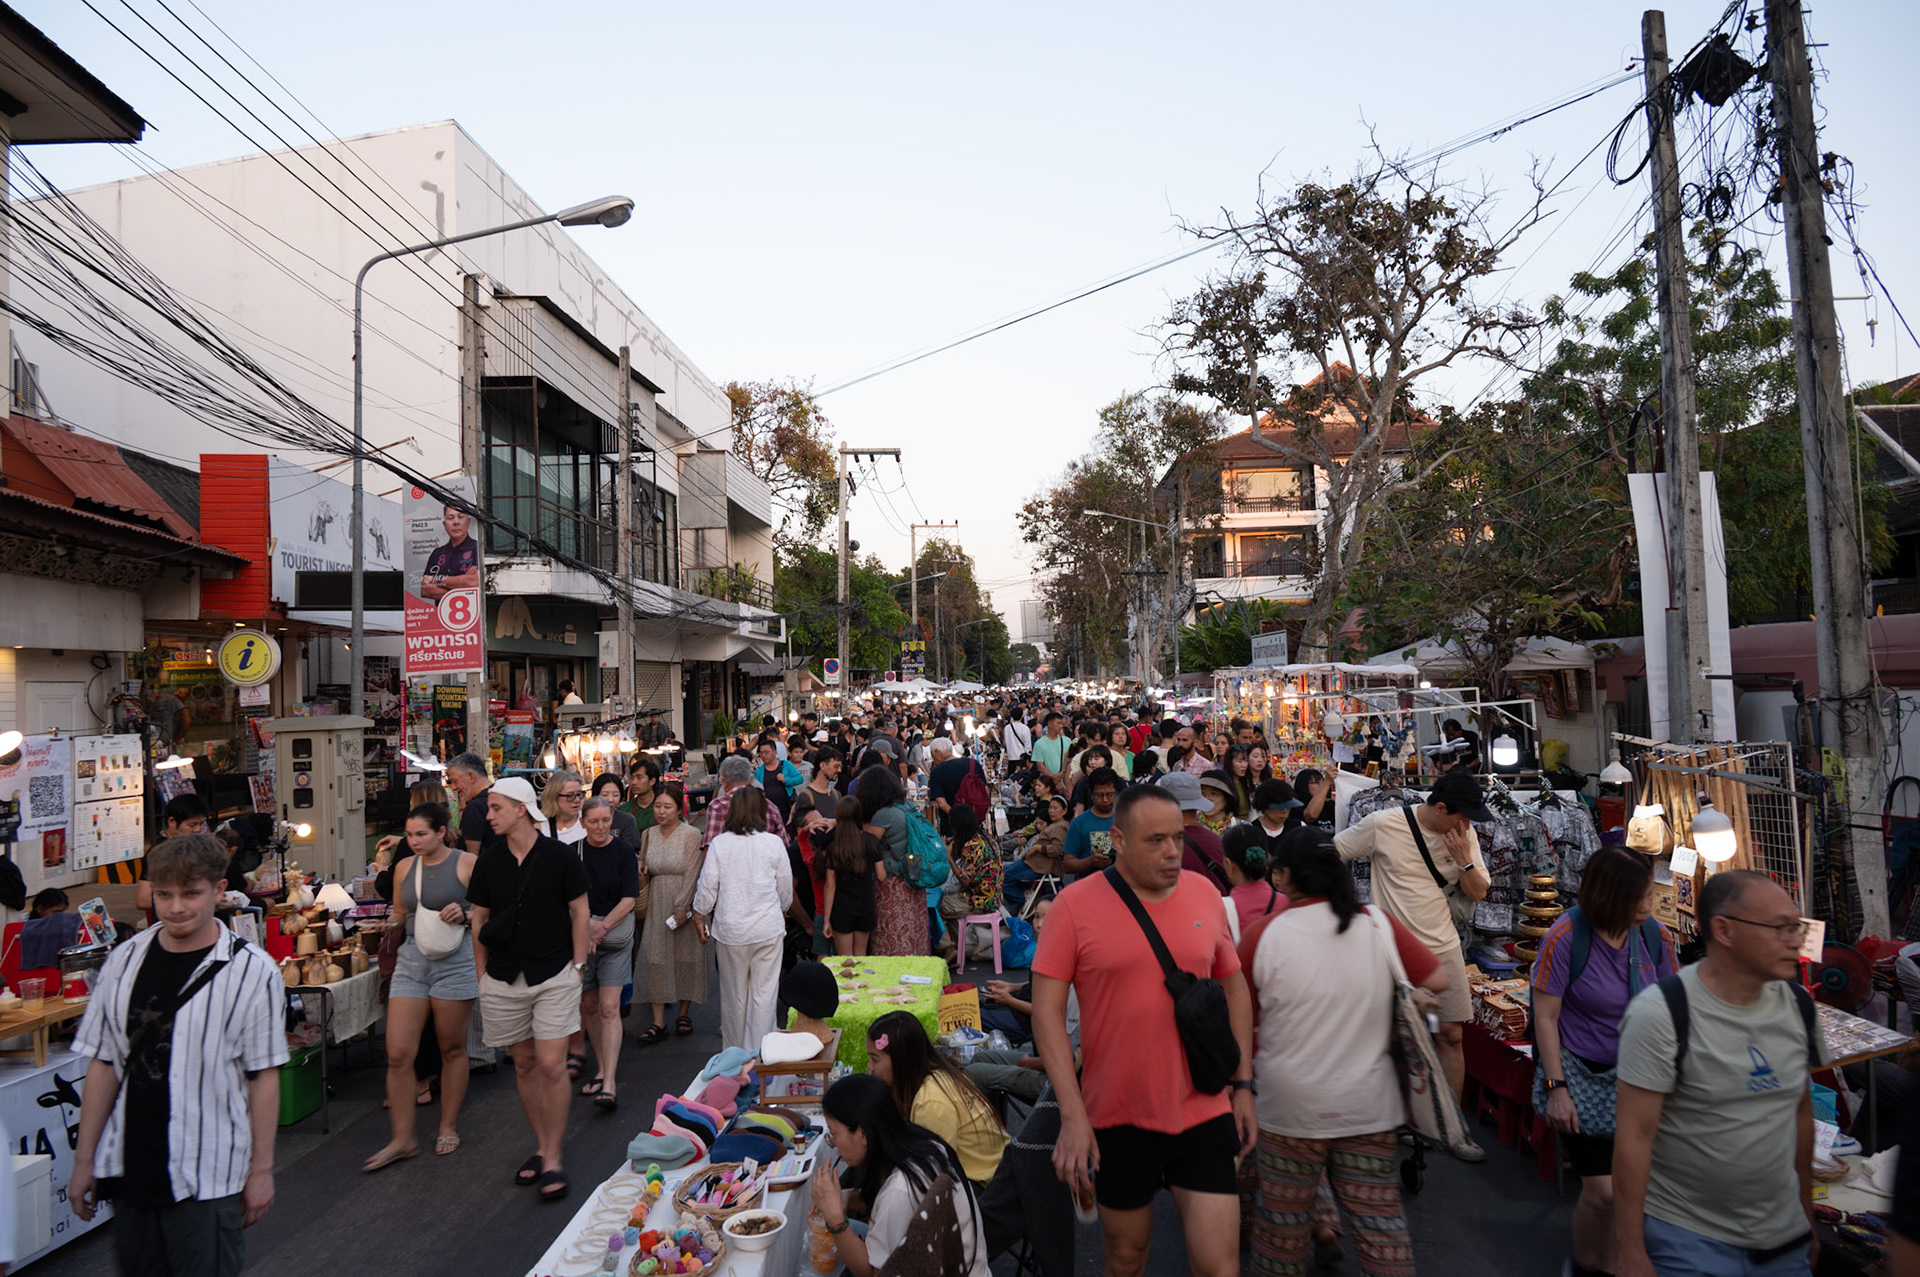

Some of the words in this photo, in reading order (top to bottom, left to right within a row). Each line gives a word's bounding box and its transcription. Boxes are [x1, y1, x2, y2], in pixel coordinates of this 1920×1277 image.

[281, 551, 323, 571] TOURIST
[448, 595, 471, 626] 8
[407, 632, 478, 649] พจนารถ
[175, 651, 196, 661] ONE
[436, 686, 467, 694] DOWNHILL
[441, 701, 462, 709] BIKING
[943, 1018, 973, 1032] TWG
